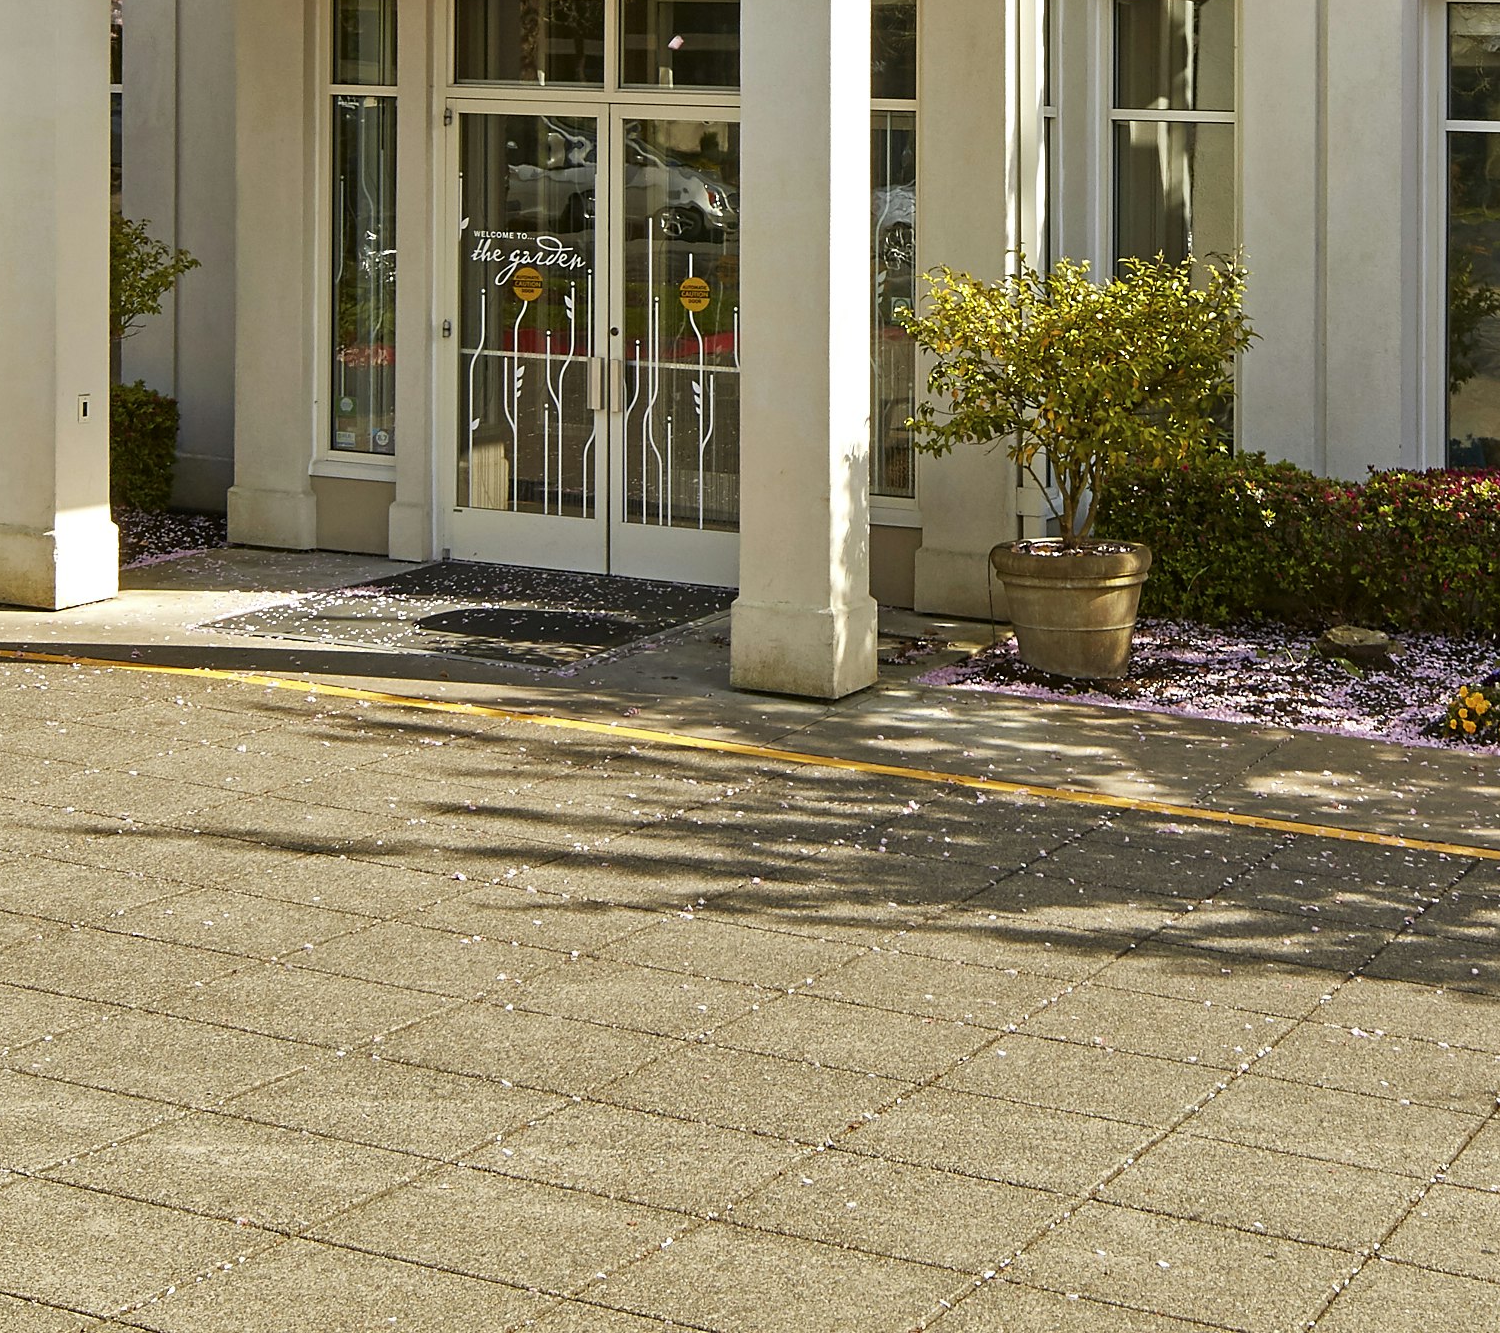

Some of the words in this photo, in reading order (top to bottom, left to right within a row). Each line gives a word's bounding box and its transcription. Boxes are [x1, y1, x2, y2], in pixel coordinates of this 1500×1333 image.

[473, 230, 514, 239] WELCOME
[471, 238, 505, 262] the
[495, 235, 586, 286] garden
[514, 280, 541, 288] CAUTION
